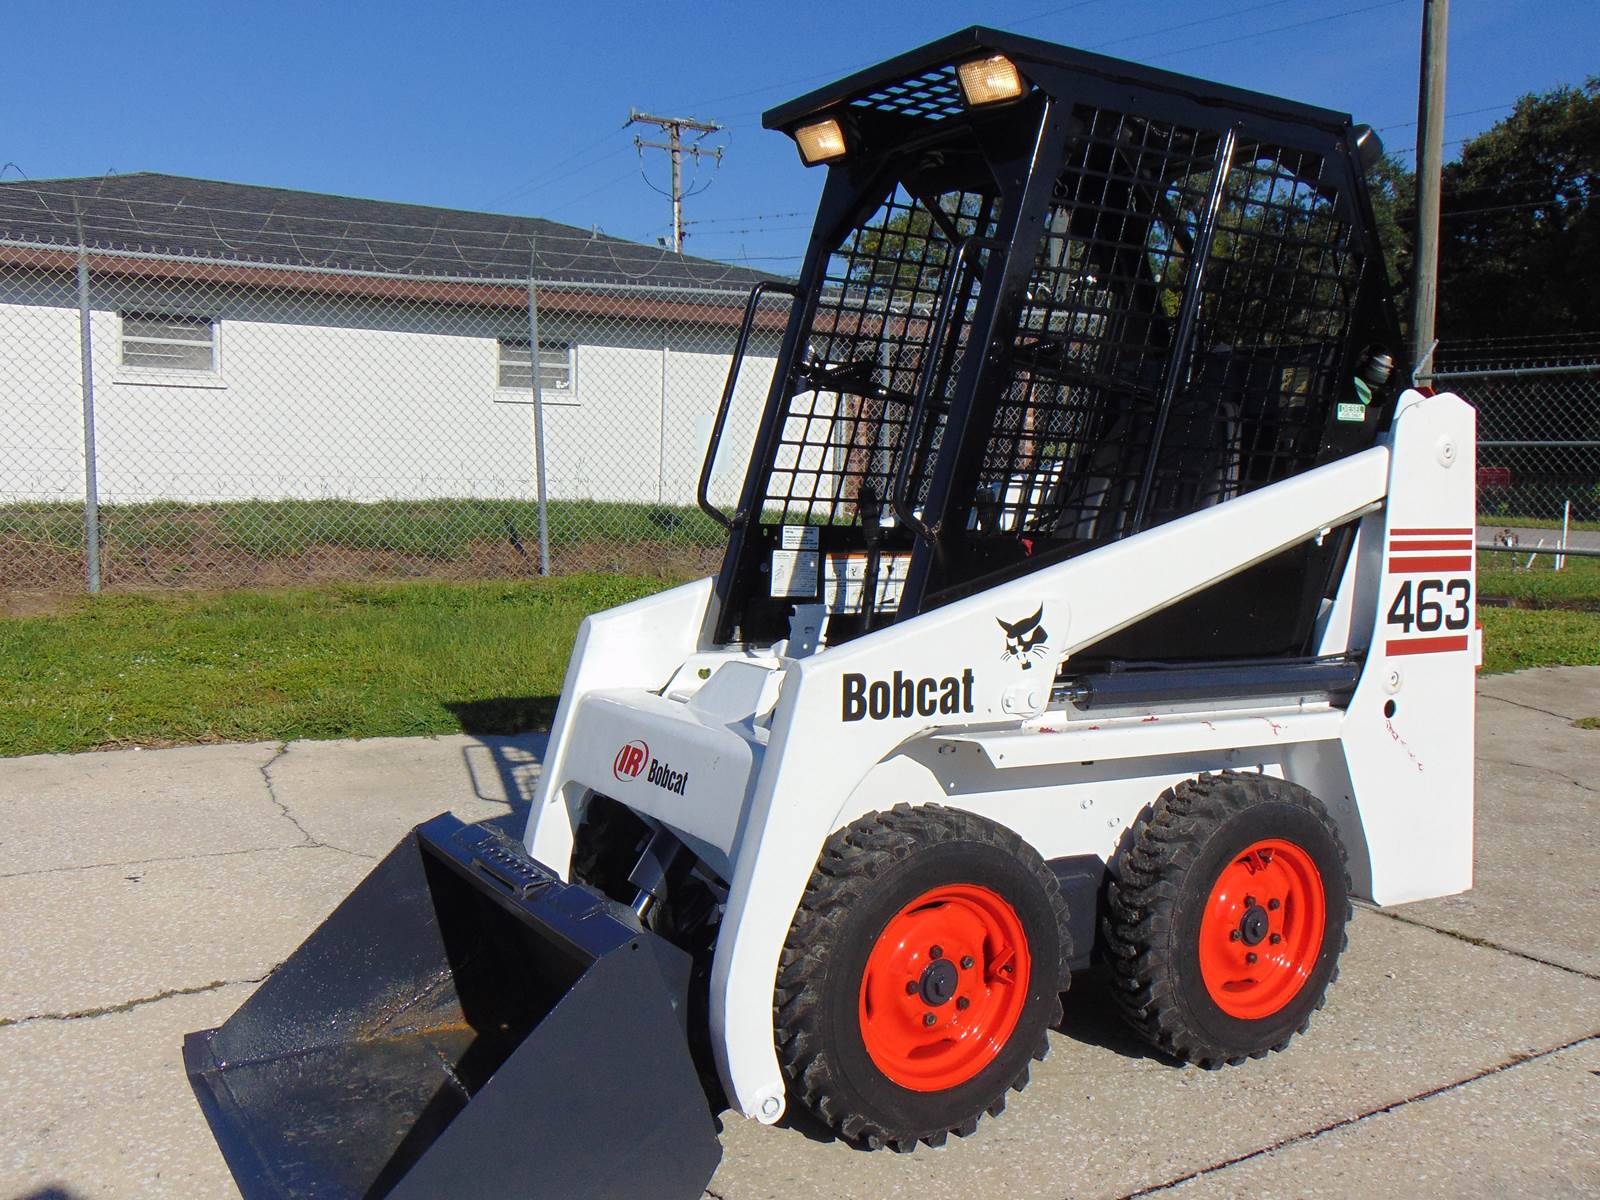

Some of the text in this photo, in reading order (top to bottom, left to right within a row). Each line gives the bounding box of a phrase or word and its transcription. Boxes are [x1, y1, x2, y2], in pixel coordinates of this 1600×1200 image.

[1387, 578, 1471, 633] 463
[842, 668, 974, 722] Bobcat
[617, 744, 689, 796] IR Bobcat
